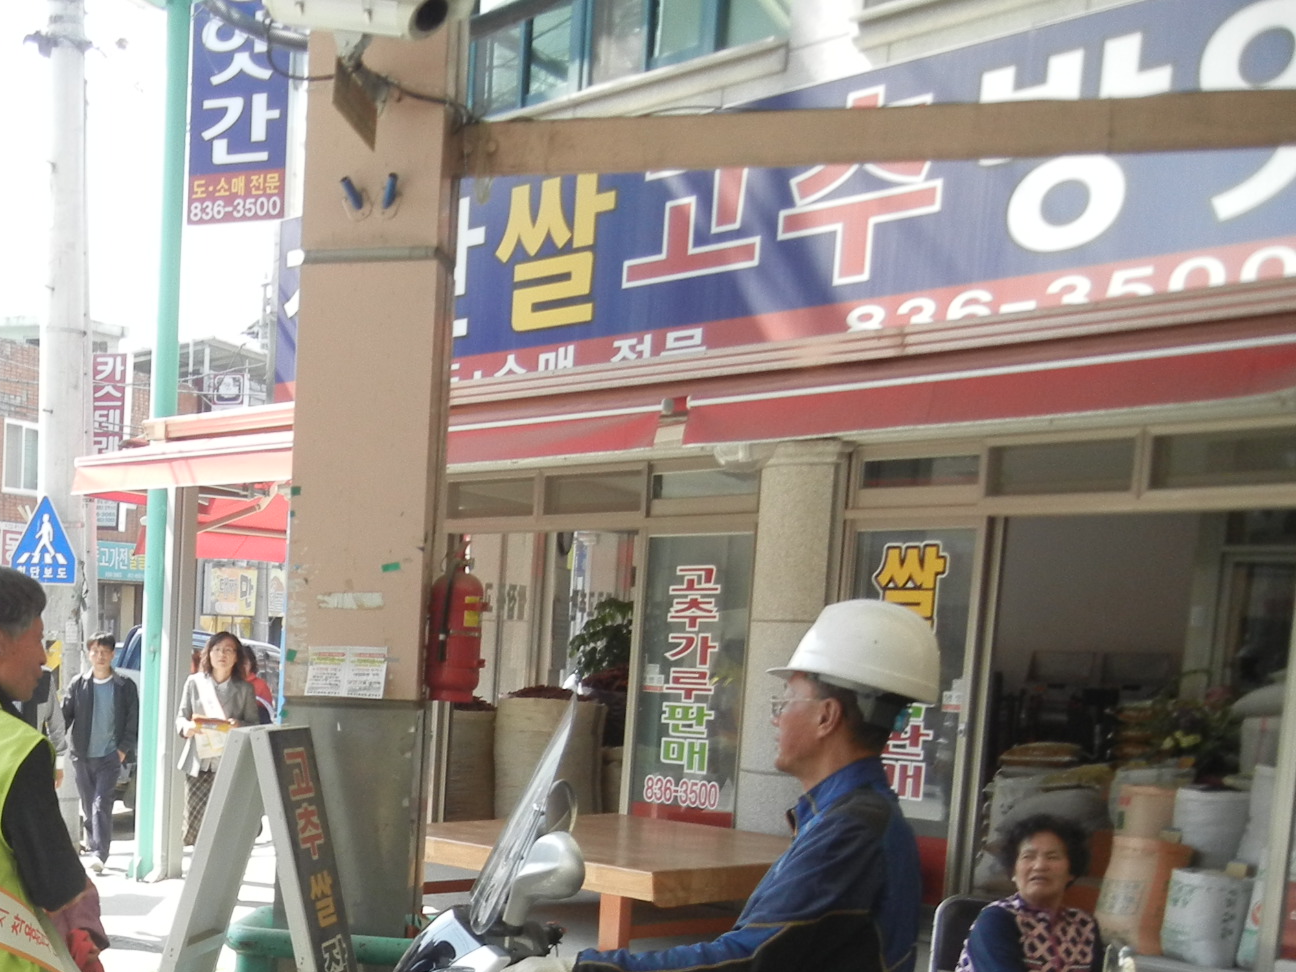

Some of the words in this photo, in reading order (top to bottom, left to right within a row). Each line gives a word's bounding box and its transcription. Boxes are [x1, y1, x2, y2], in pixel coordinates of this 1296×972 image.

[249, 173, 281, 193] 전문
[189, 196, 281, 221] 836-3500
[495, 172, 616, 333] 쌀
[283, 747, 325, 860] 고추
[644, 775, 720, 809] 836-3500
[309, 869, 339, 928] 쌀
